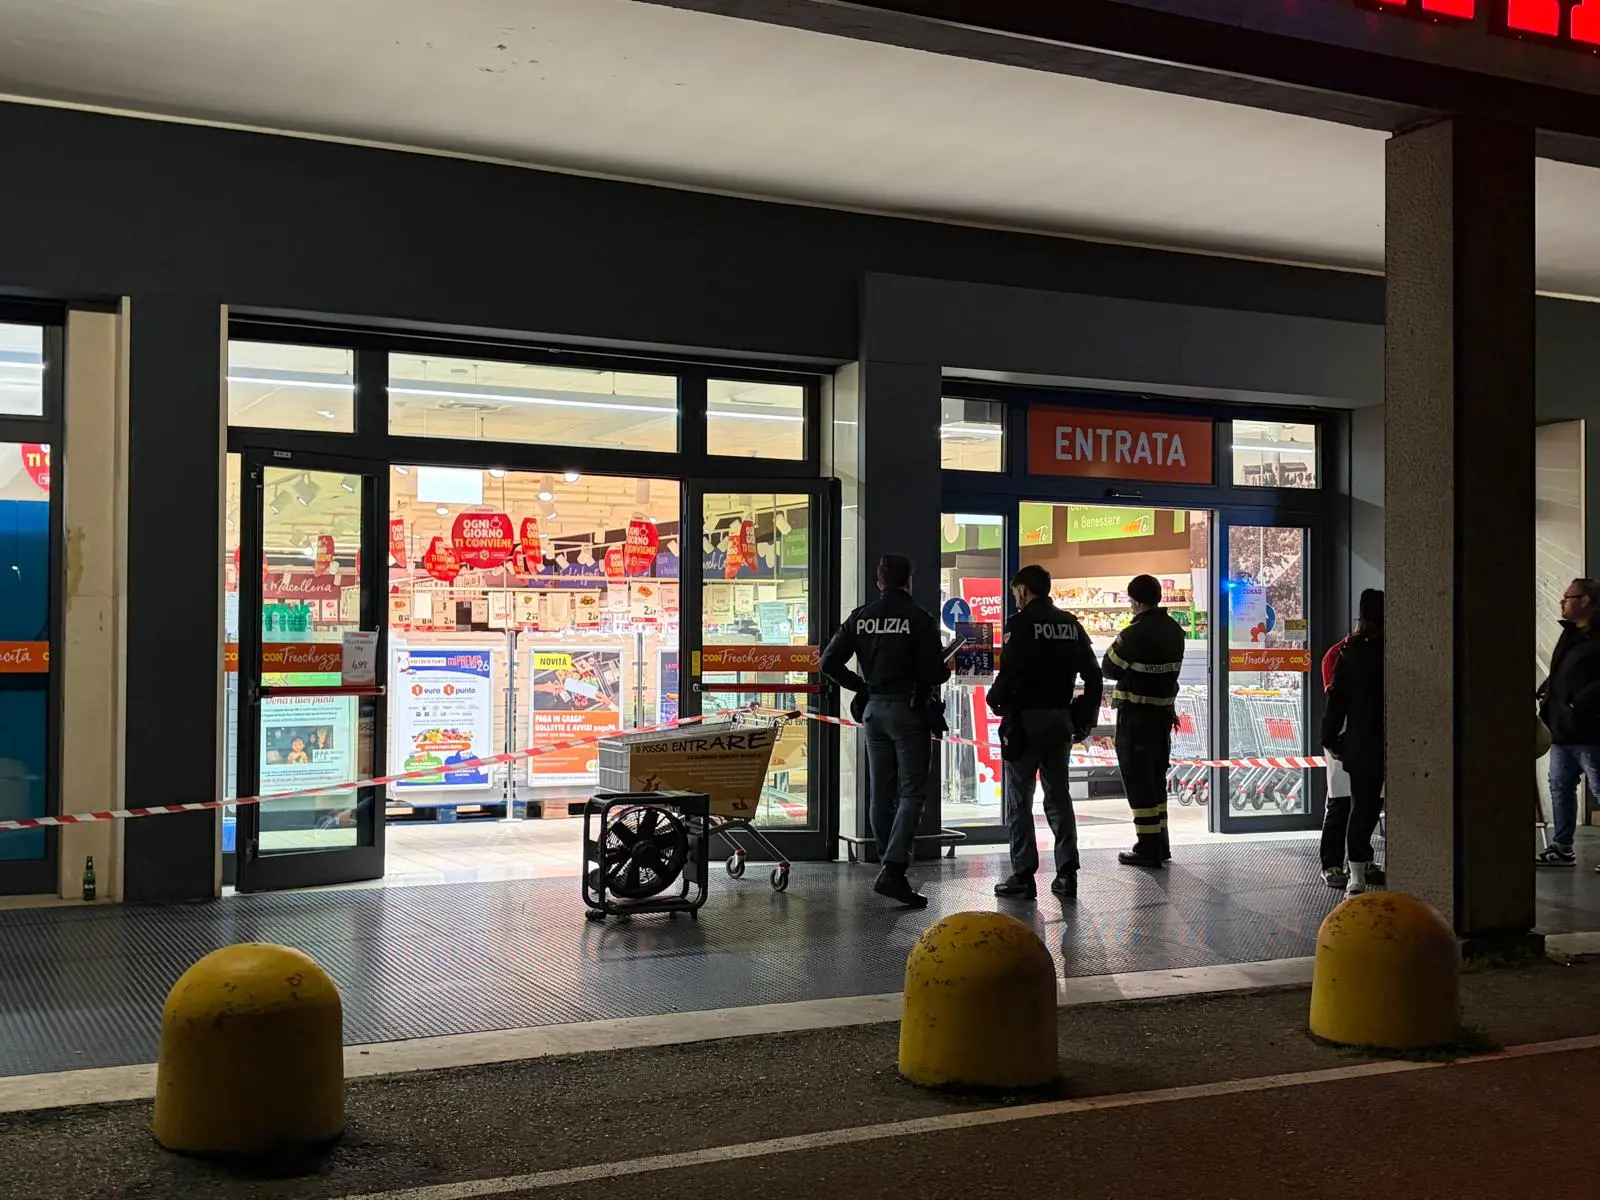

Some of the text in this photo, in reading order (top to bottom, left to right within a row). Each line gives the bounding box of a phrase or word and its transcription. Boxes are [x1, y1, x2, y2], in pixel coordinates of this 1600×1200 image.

[1056, 426, 1186, 467] ENTRATA
[27, 453, 41, 467] TI
[463, 519, 489, 529] OGNI
[1081, 515, 1121, 529] Benessere
[463, 529, 503, 539] GIORNO
[454, 538, 464, 548] TI
[856, 618, 911, 635] POLIZIA
[1034, 623, 1079, 640] POLIZIA
[476, 660, 490, 672] 26
[540, 656, 568, 667] NOVITÀ
[456, 686, 476, 696] punto
[671, 731, 772, 753] ENTRARE
